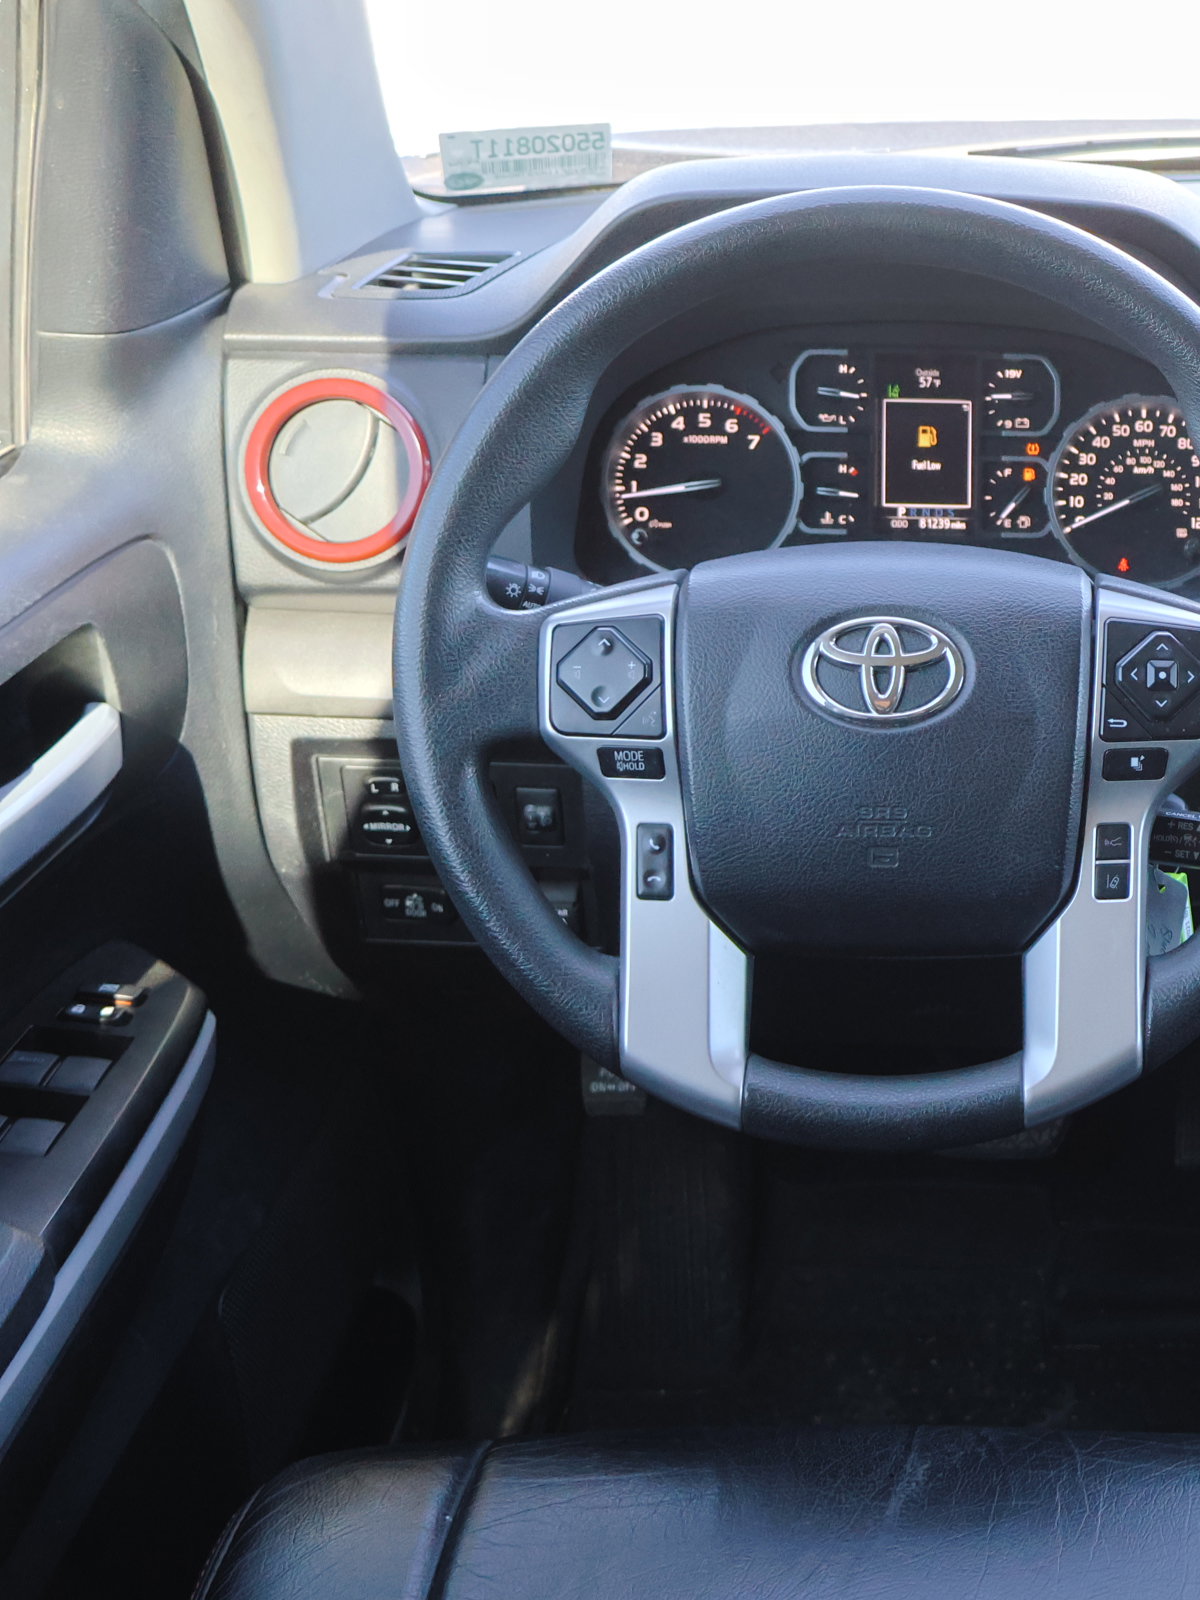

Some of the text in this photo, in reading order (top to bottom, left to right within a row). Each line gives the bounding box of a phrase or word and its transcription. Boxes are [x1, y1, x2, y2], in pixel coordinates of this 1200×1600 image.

[670, 416, 686, 431] 4
[698, 413, 712, 428] 5
[724, 418, 739, 434] 6
[1134, 420, 1153, 433] 60
[1112, 424, 1130, 437] 50
[1159, 425, 1176, 438] 70
[650, 432, 664, 447] 3
[746, 434, 761, 450] 7
[1092, 436, 1110, 449] 40
[1133, 439, 1155, 448] MPH
[633, 453, 648, 469] 2
[911, 459, 942, 471] Fuel Low
[1078, 453, 1097, 466] 30
[1139, 456, 1152, 464] 100
[1153, 460, 1165, 468] 120
[838, 463, 848, 474] H
[1113, 465, 1124, 473] 60
[1133, 466, 1155, 475] km/h
[1162, 470, 1175, 478] 140
[1069, 473, 1088, 486] 20
[1105, 477, 1115, 485] 40
[1069, 496, 1085, 508] 10
[1103, 492, 1113, 500] 20
[634, 506, 650, 522] 0
[614, 750, 645, 761] MODE
[623, 761, 645, 771] HOLD
[370, 782, 399, 794] L R
[369, 821, 405, 832] MIRROR
[1177, 821, 1194, 831] RES
[1175, 849, 1191, 859] SET
